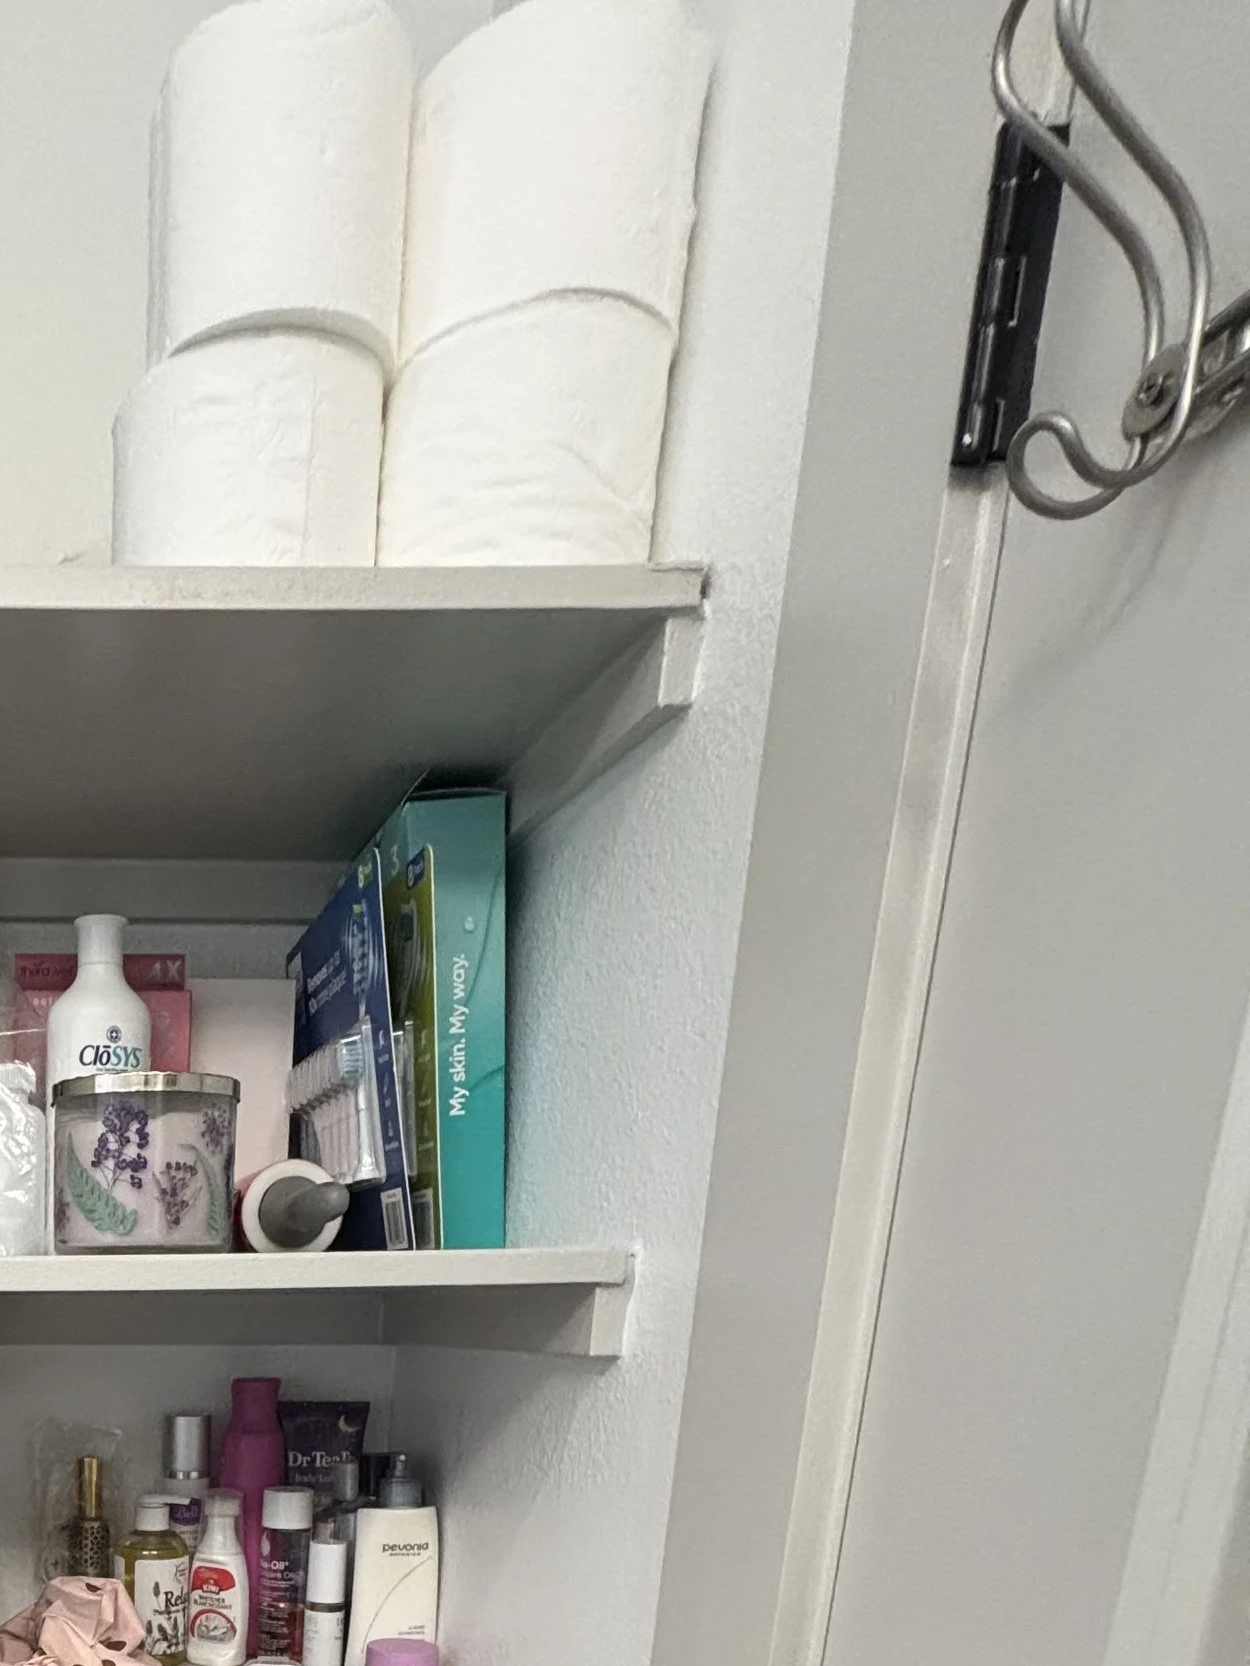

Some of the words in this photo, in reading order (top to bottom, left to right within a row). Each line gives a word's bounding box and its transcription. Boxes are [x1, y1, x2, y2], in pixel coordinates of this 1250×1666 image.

[453, 953, 469, 1000] way.
[449, 1003, 469, 1034] My
[449, 1039, 466, 1082] skin.
[449, 1086, 469, 1116] My
[288, 1450, 311, 1467] Dr
[382, 1542, 429, 1553] pevonia
